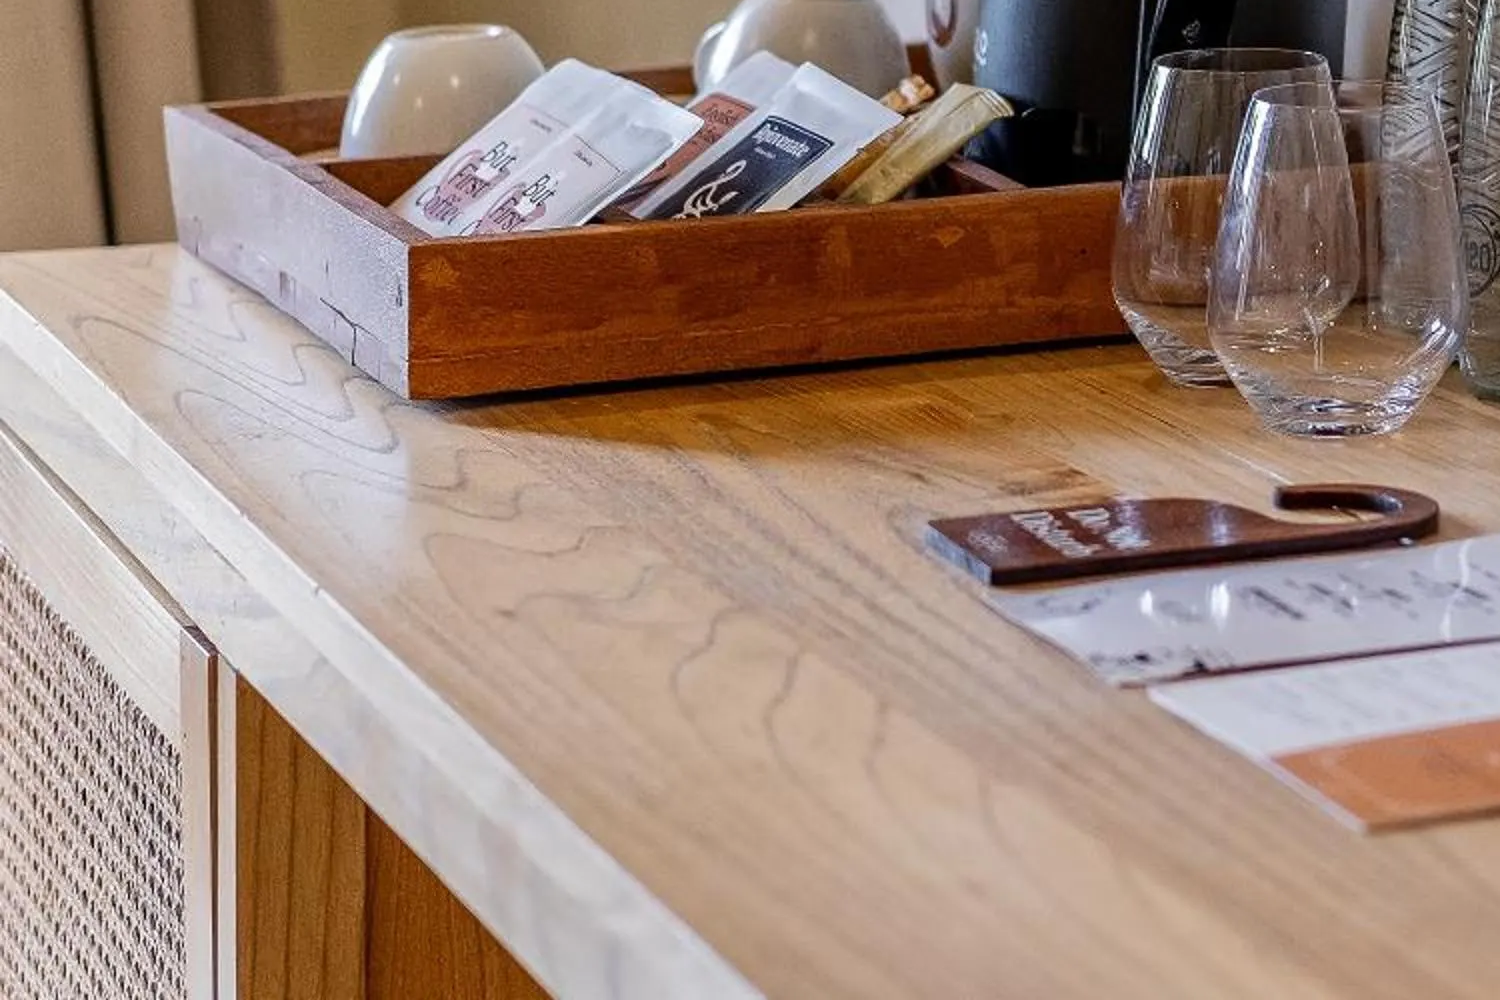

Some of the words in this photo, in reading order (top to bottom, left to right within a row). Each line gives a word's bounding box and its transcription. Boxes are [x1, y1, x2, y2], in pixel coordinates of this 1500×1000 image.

[480, 141, 517, 172] But
[448, 163, 491, 198] First
[522, 173, 557, 206] But
[416, 185, 465, 225] Coffee
[489, 196, 526, 232] First
